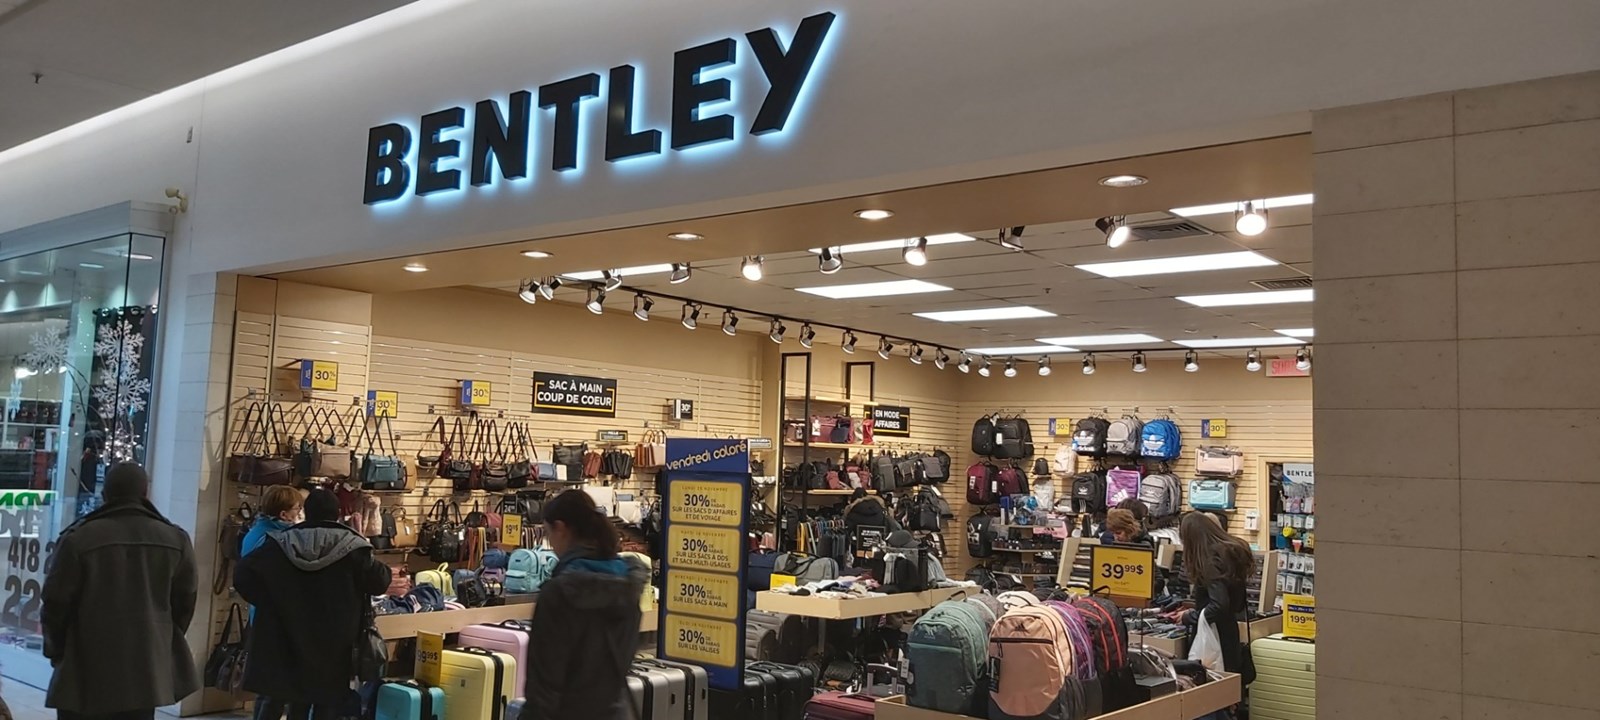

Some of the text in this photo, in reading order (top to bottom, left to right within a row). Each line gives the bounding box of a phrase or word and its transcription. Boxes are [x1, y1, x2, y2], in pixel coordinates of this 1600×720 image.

[363, 11, 836, 206] BENTLEY
[549, 379, 602, 393] SAC À MAIN
[537, 391, 612, 406] COUP DE COEUR
[875, 409, 900, 419] EN MODE
[874, 419, 900, 429] AFFAIRES
[666, 440, 746, 471] vendredi coloré
[684, 493, 710, 507] 30%
[708, 508, 737, 516] D'AFFAIRES
[682, 538, 708, 552] 30%
[8, 537, 40, 573] 418
[680, 583, 706, 599] 30%
[713, 599, 728, 608] MAIN
[679, 628, 705, 644] 30%
[698, 645, 720, 654] VALISES
